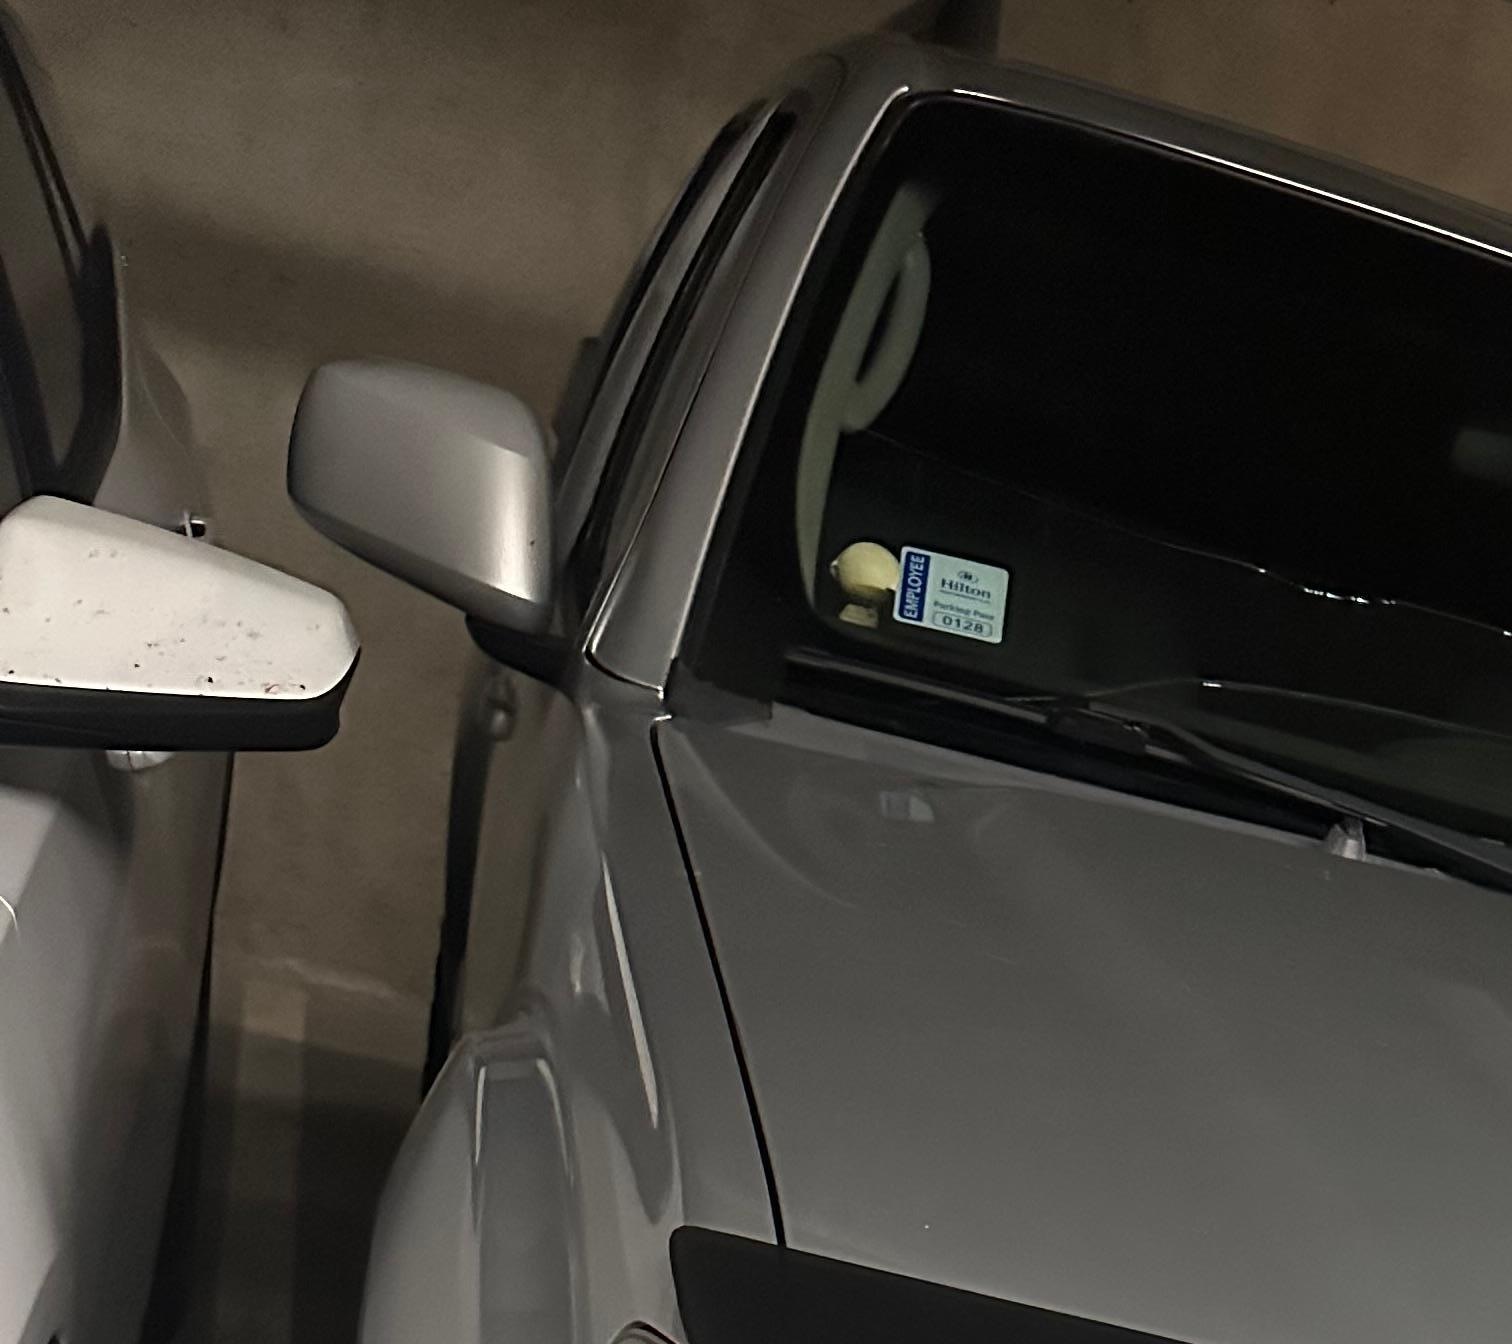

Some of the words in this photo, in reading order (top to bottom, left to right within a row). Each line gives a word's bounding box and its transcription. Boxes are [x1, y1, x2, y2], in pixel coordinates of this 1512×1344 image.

[903, 554, 926, 619] EMPLOYEE
[941, 577, 991, 599] Hilton
[942, 615, 983, 634] 0128
